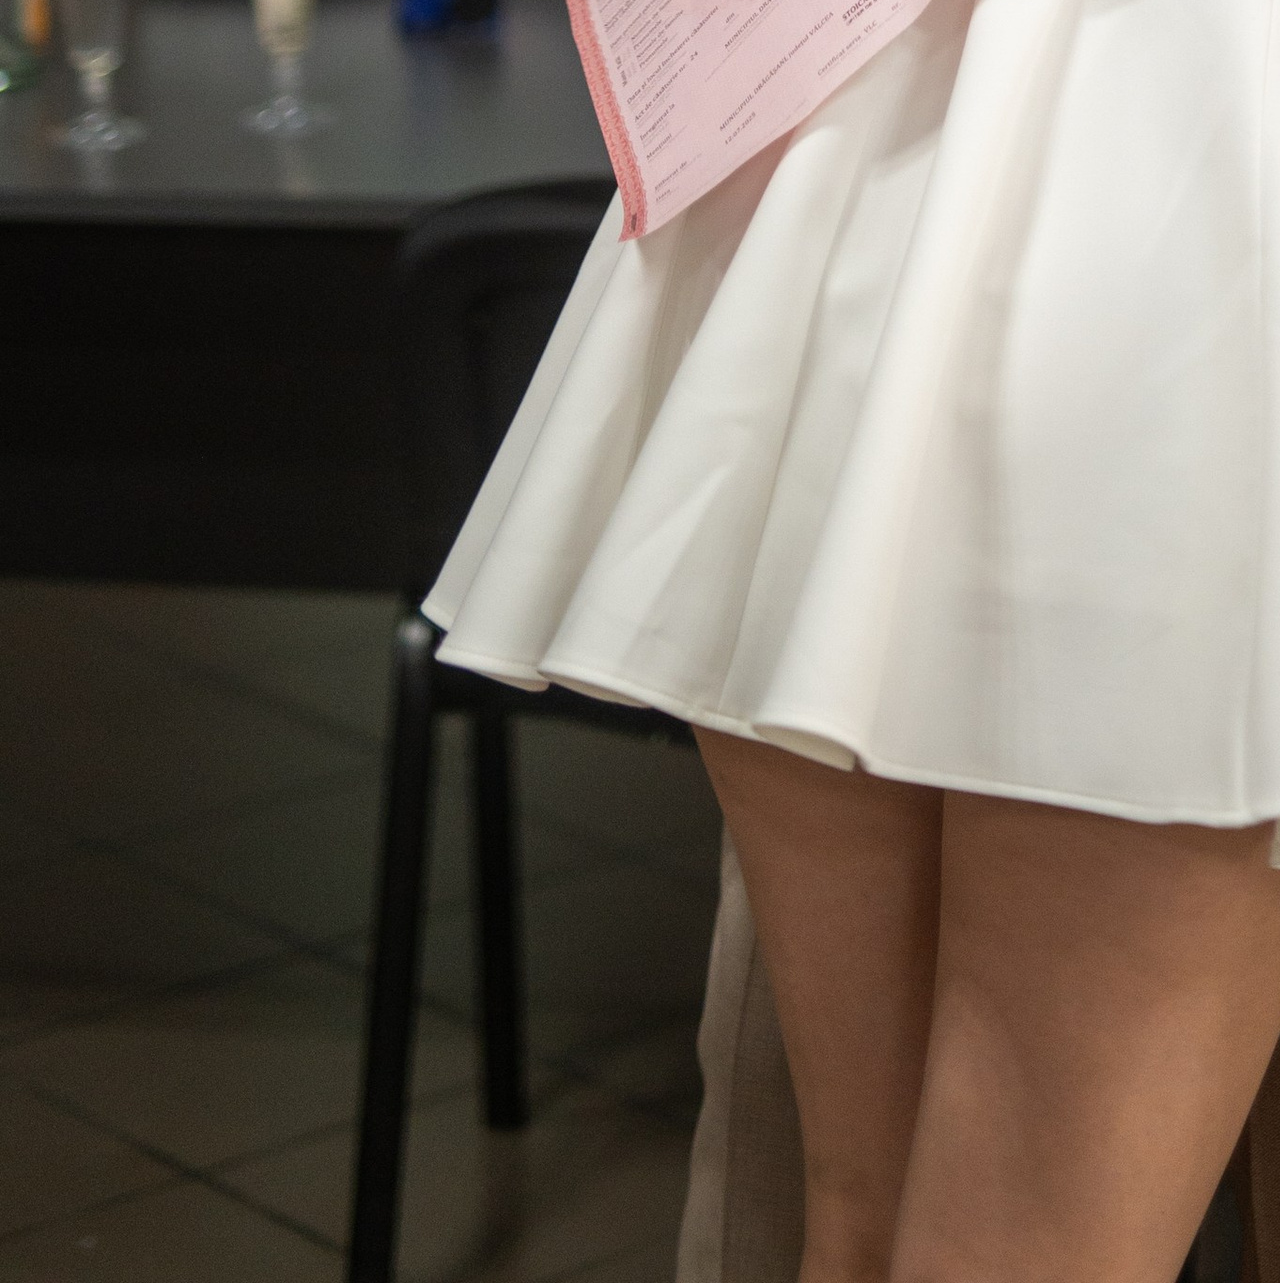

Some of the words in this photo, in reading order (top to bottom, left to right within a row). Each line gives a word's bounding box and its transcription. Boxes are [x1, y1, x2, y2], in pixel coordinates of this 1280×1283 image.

[724, 12, 759, 50] MUNICIPIUL
[817, 48, 846, 77] Certificat
[863, 19, 878, 34] VLC
[634, 109, 645, 123] Act
[644, 101, 652, 112] de
[690, 50, 699, 62] 24
[719, 93, 755, 132] MUNICIPIUL
